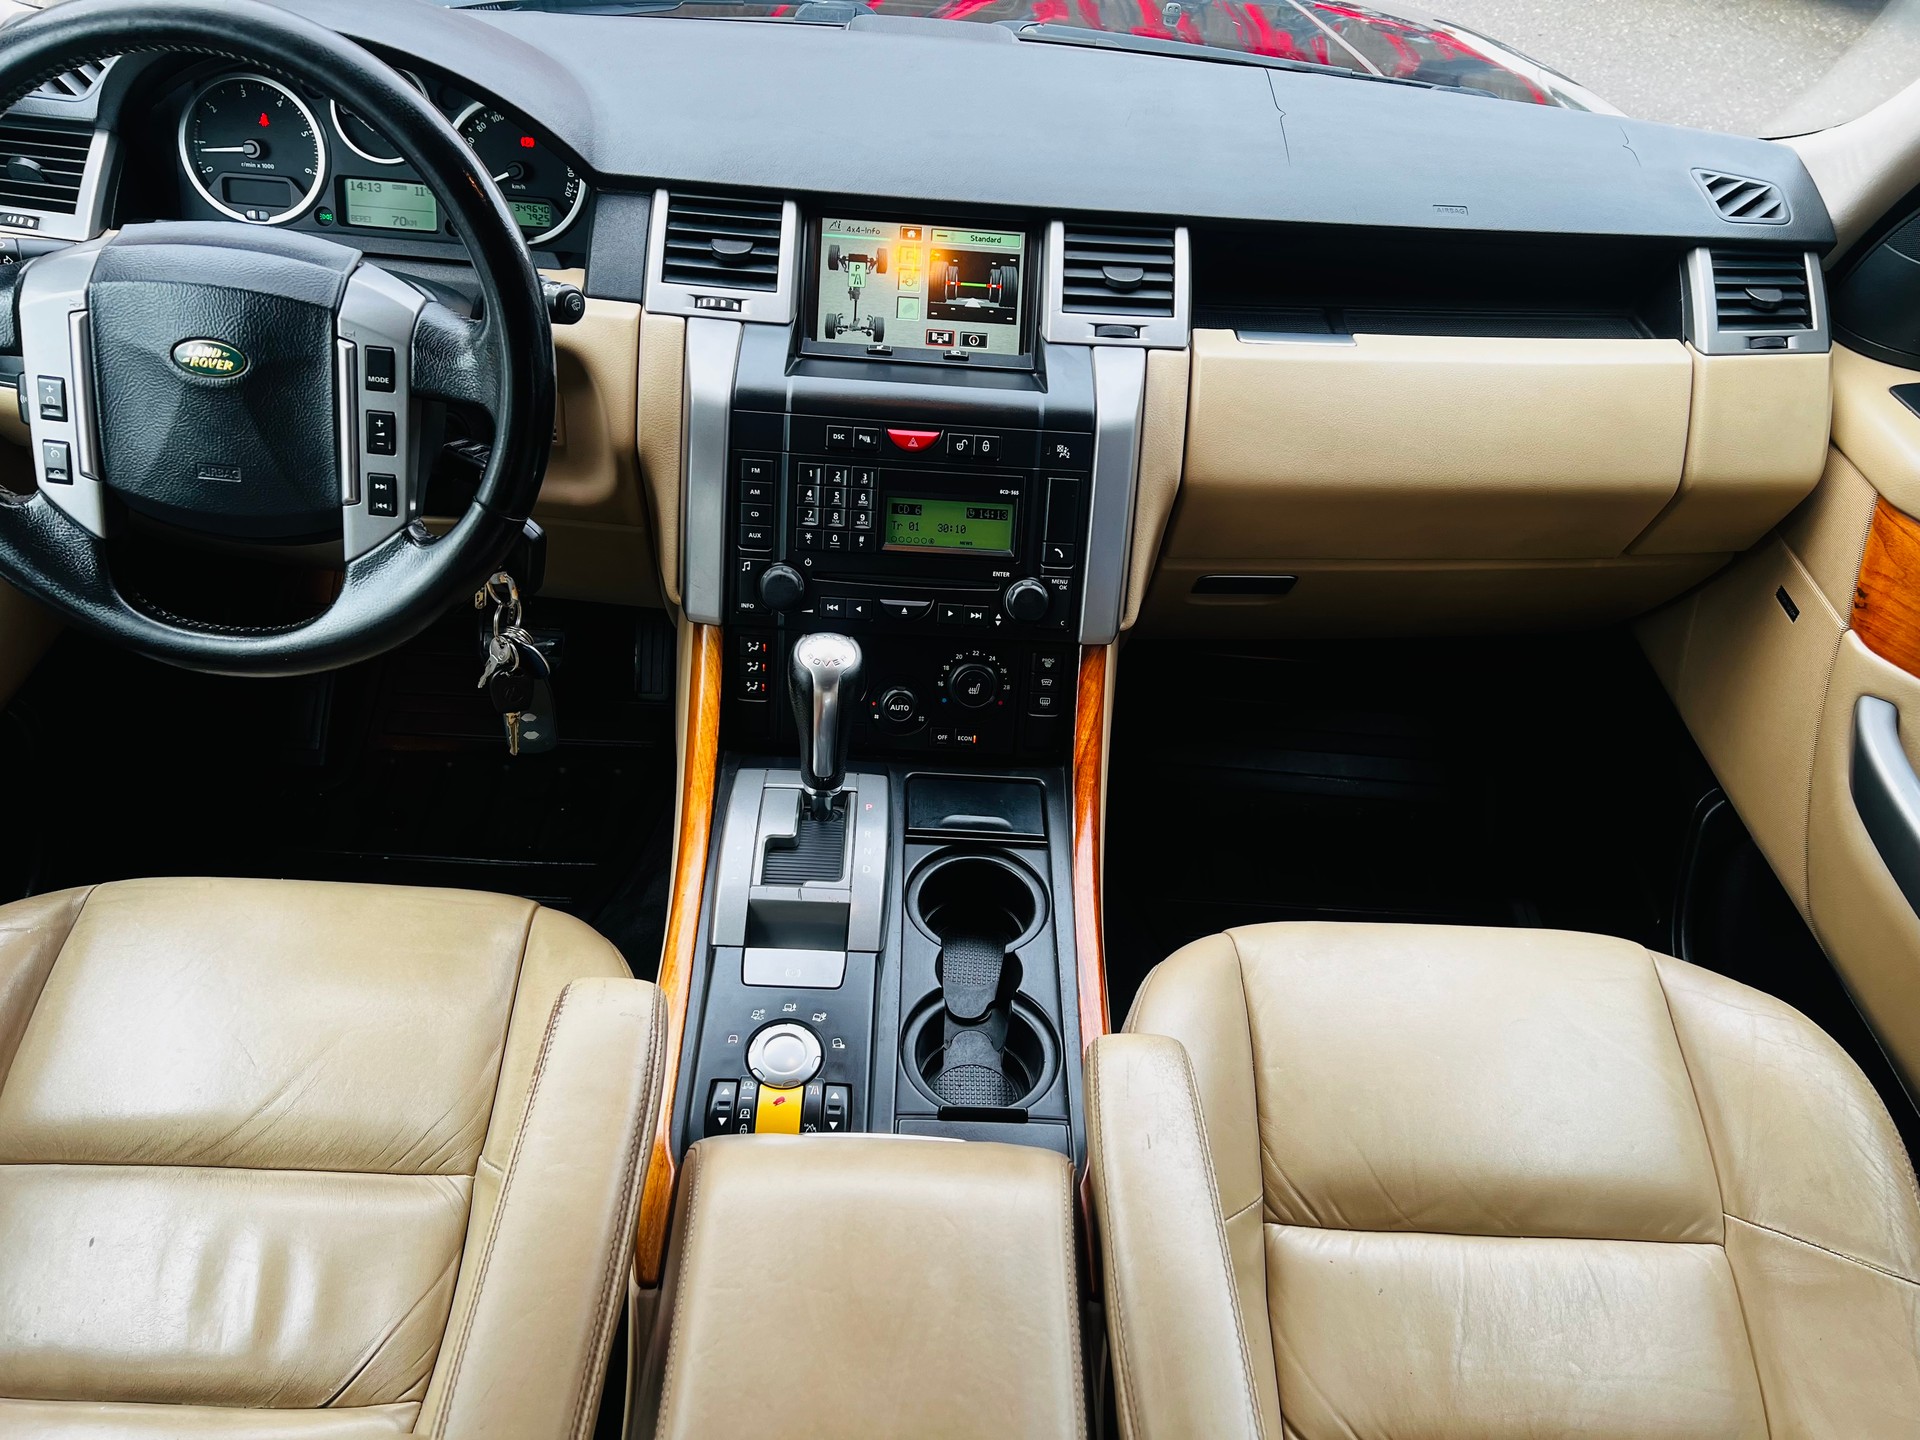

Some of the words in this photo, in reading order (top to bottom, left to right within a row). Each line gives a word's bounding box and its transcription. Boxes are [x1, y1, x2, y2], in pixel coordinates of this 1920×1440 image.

[240, 89, 247, 98] 3
[276, 100, 283, 108] 4
[209, 105, 217, 114] 2
[476, 122, 487, 133] 80
[304, 167, 313, 175] 6
[350, 181, 382, 193] 14:13
[564, 181, 575, 198] 220
[515, 203, 550, 214] 349640
[527, 212, 550, 223] 7925
[846, 225, 881, 235] 4x4-Info
[970, 234, 1002, 244] Standard
[855, 264, 861, 272] P
[186, 344, 222, 358] LAND
[189, 355, 234, 371] ROVER
[367, 375, 390, 384] MODE
[808, 469, 813, 477] 1
[835, 471, 841, 479] 2
[862, 472, 868, 481] 3
[806, 489, 813, 497] 4
[834, 491, 840, 499] 5
[860, 493, 866, 501] 6
[897, 504, 910, 514] CD
[807, 510, 813, 518] 7
[832, 512, 839, 520] 8
[859, 513, 866, 522] 9
[979, 509, 1008, 520] 14:13
[892, 520, 903, 531] Tr
[908, 522, 920, 532] 01
[937, 523, 967, 534] 30:10
[832, 534, 838, 542] 0
[865, 803, 873, 811] P
[864, 830, 871, 838] R
[864, 847, 872, 855] N
[862, 864, 871, 873] D
